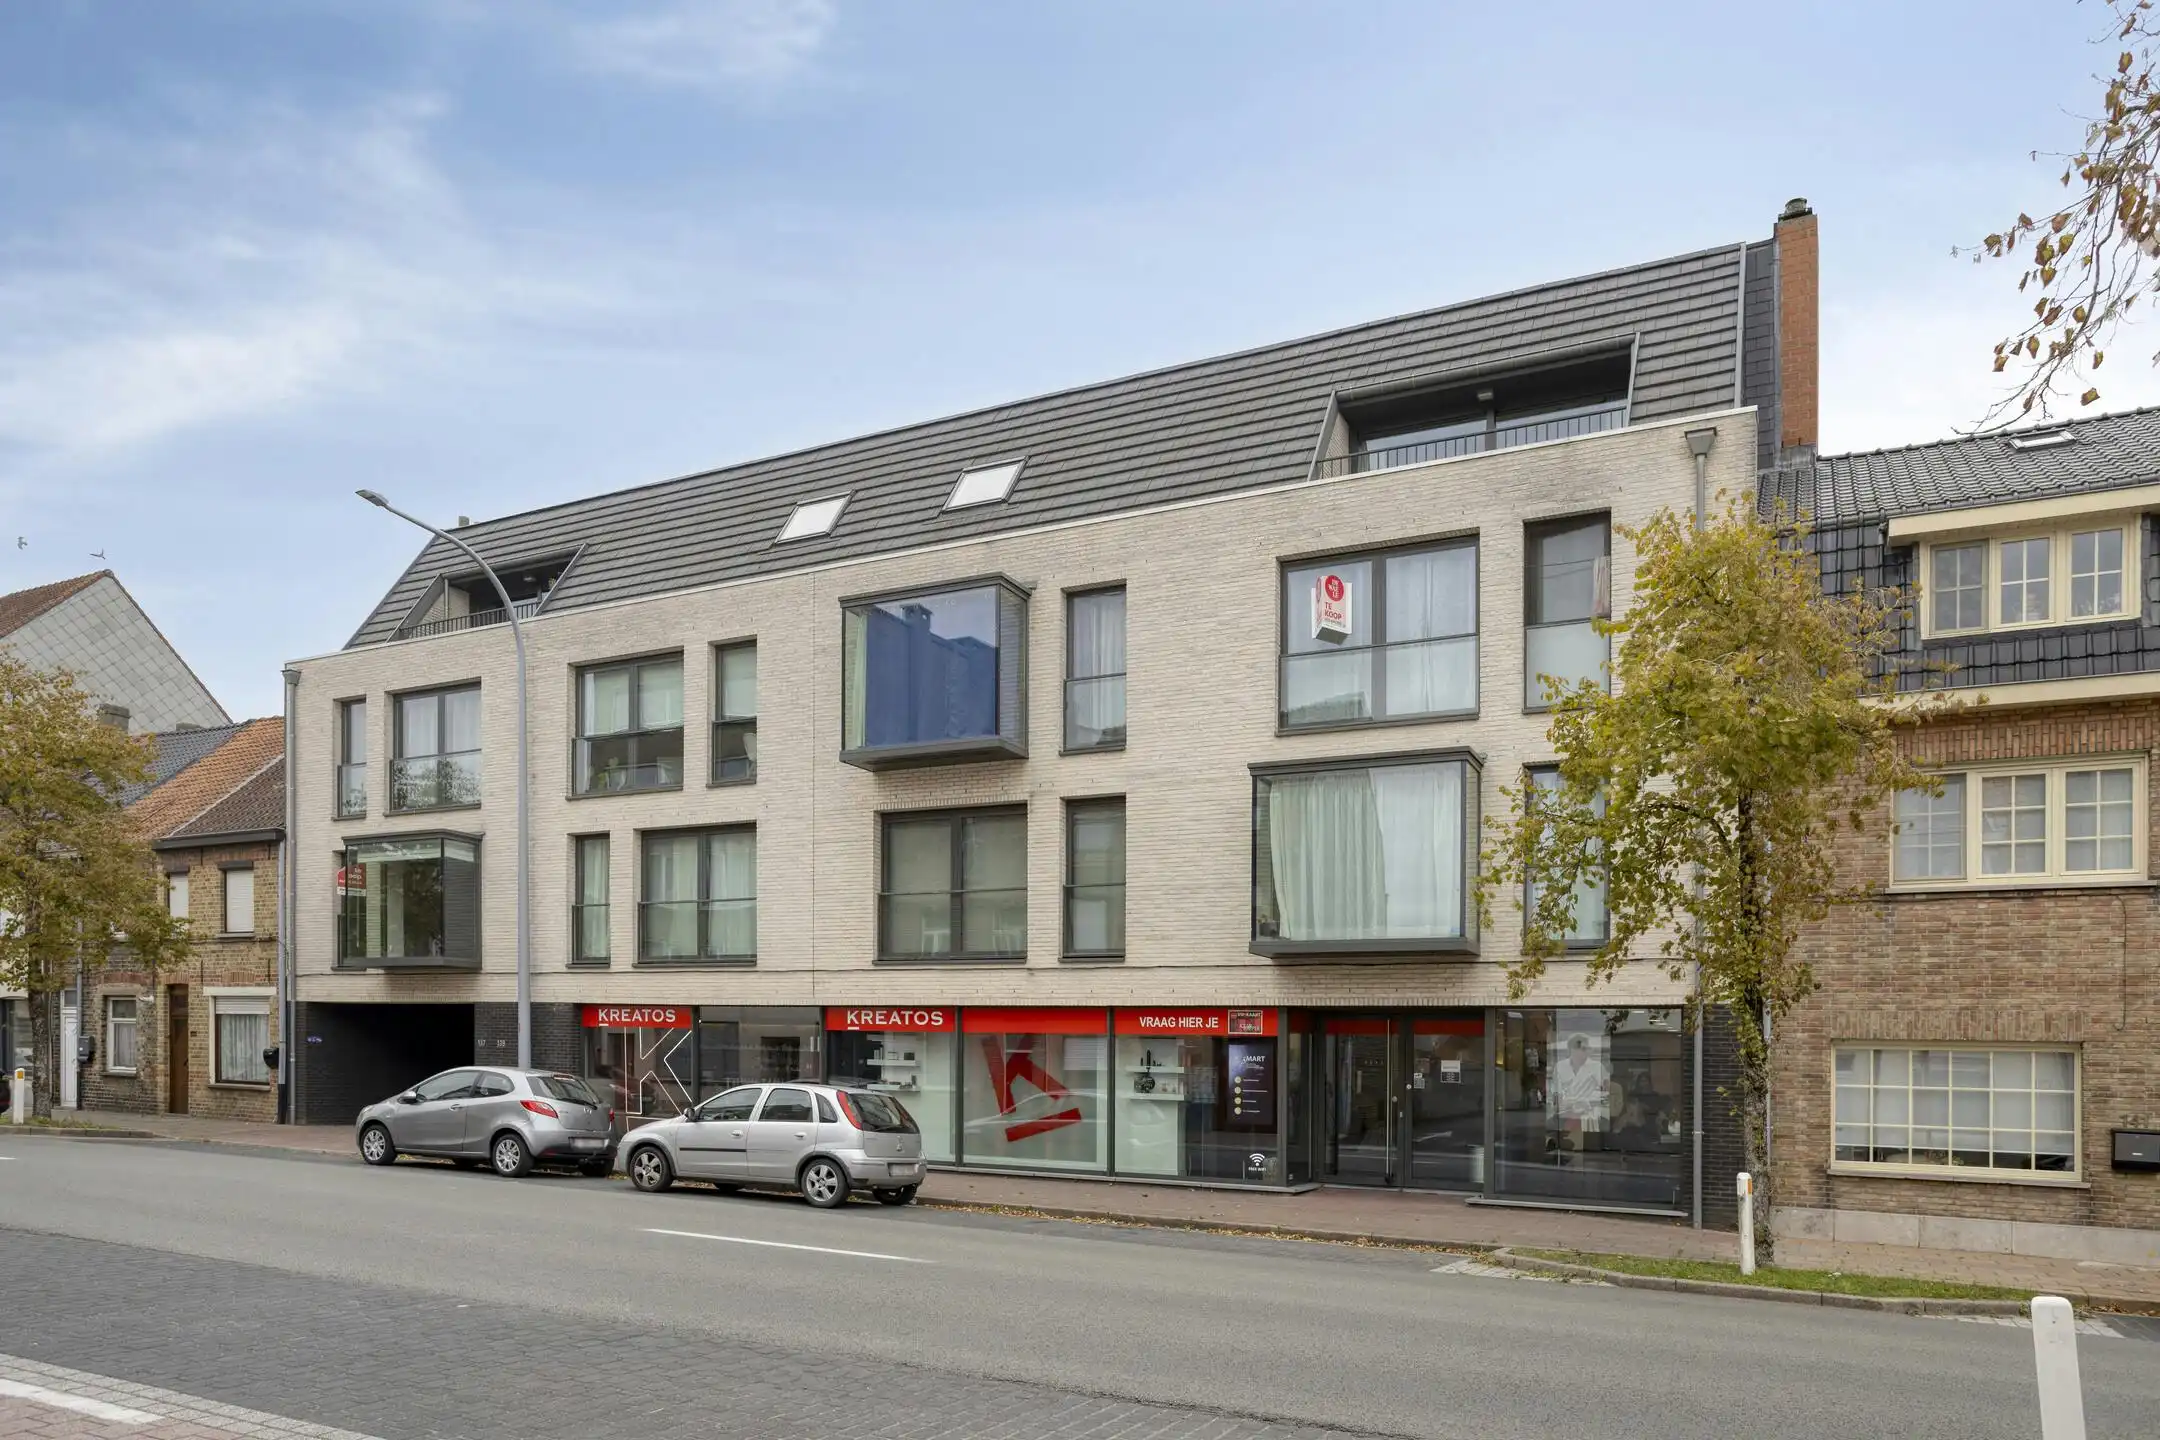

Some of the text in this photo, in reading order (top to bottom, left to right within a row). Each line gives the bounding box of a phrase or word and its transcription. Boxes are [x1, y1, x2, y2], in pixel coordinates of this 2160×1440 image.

[1325, 601, 1332, 610] TE
[1324, 609, 1342, 620] KOOP
[598, 1008, 676, 1023] KREATOS
[847, 1010, 944, 1026] KREATOS
[1139, 1016, 1219, 1028] VRAAG HIER JE
